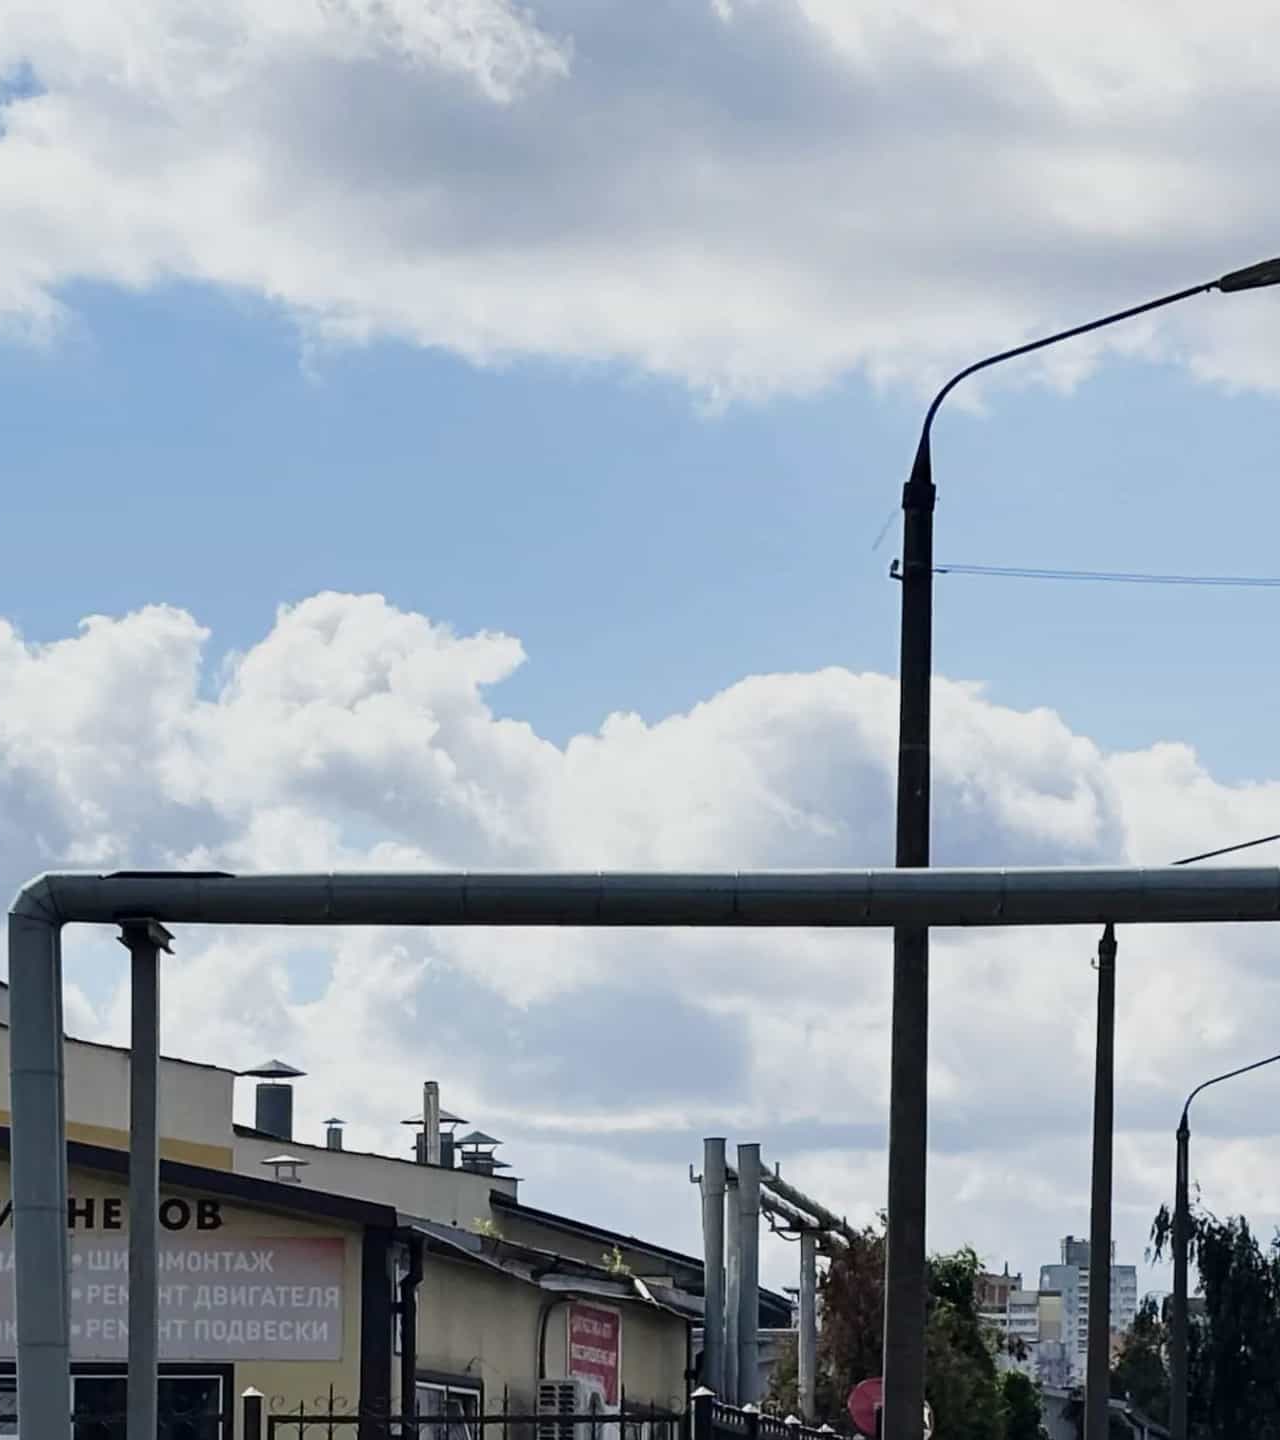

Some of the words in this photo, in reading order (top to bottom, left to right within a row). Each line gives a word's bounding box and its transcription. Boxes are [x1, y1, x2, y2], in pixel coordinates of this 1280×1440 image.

[87, 1250, 274, 1272] ШИМОНТАЖ
[194, 1286, 339, 1310] ДВИГАТЕЛЯ
[194, 1320, 329, 1343] ПОДВЕСКИ
